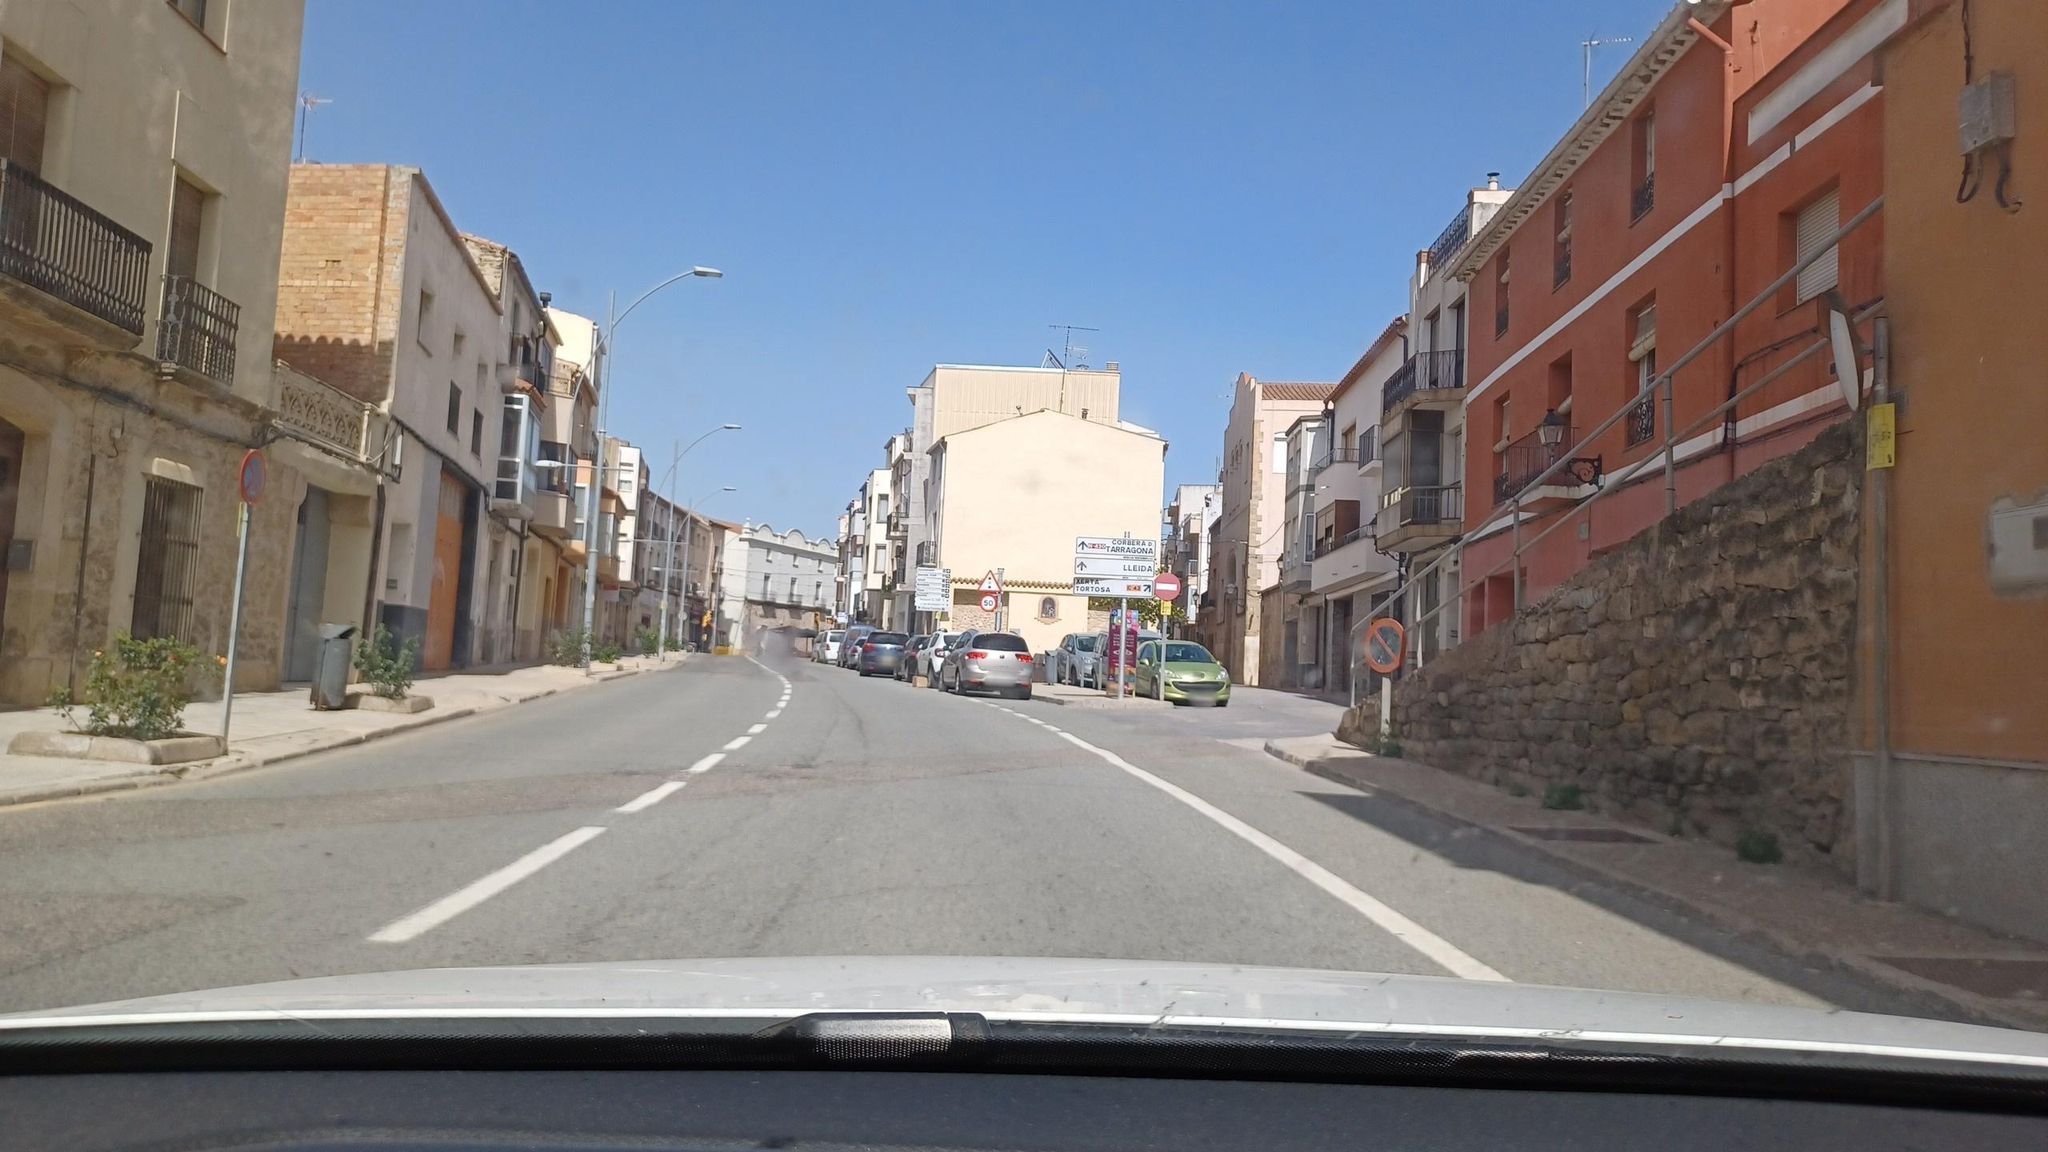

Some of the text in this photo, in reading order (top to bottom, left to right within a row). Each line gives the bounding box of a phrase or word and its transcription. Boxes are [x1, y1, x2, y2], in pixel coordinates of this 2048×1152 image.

[1105, 545, 1154, 554] TARRAGONA
[1123, 564, 1153, 572] LLEIDA
[1076, 585, 1111, 593] TORTOSA
